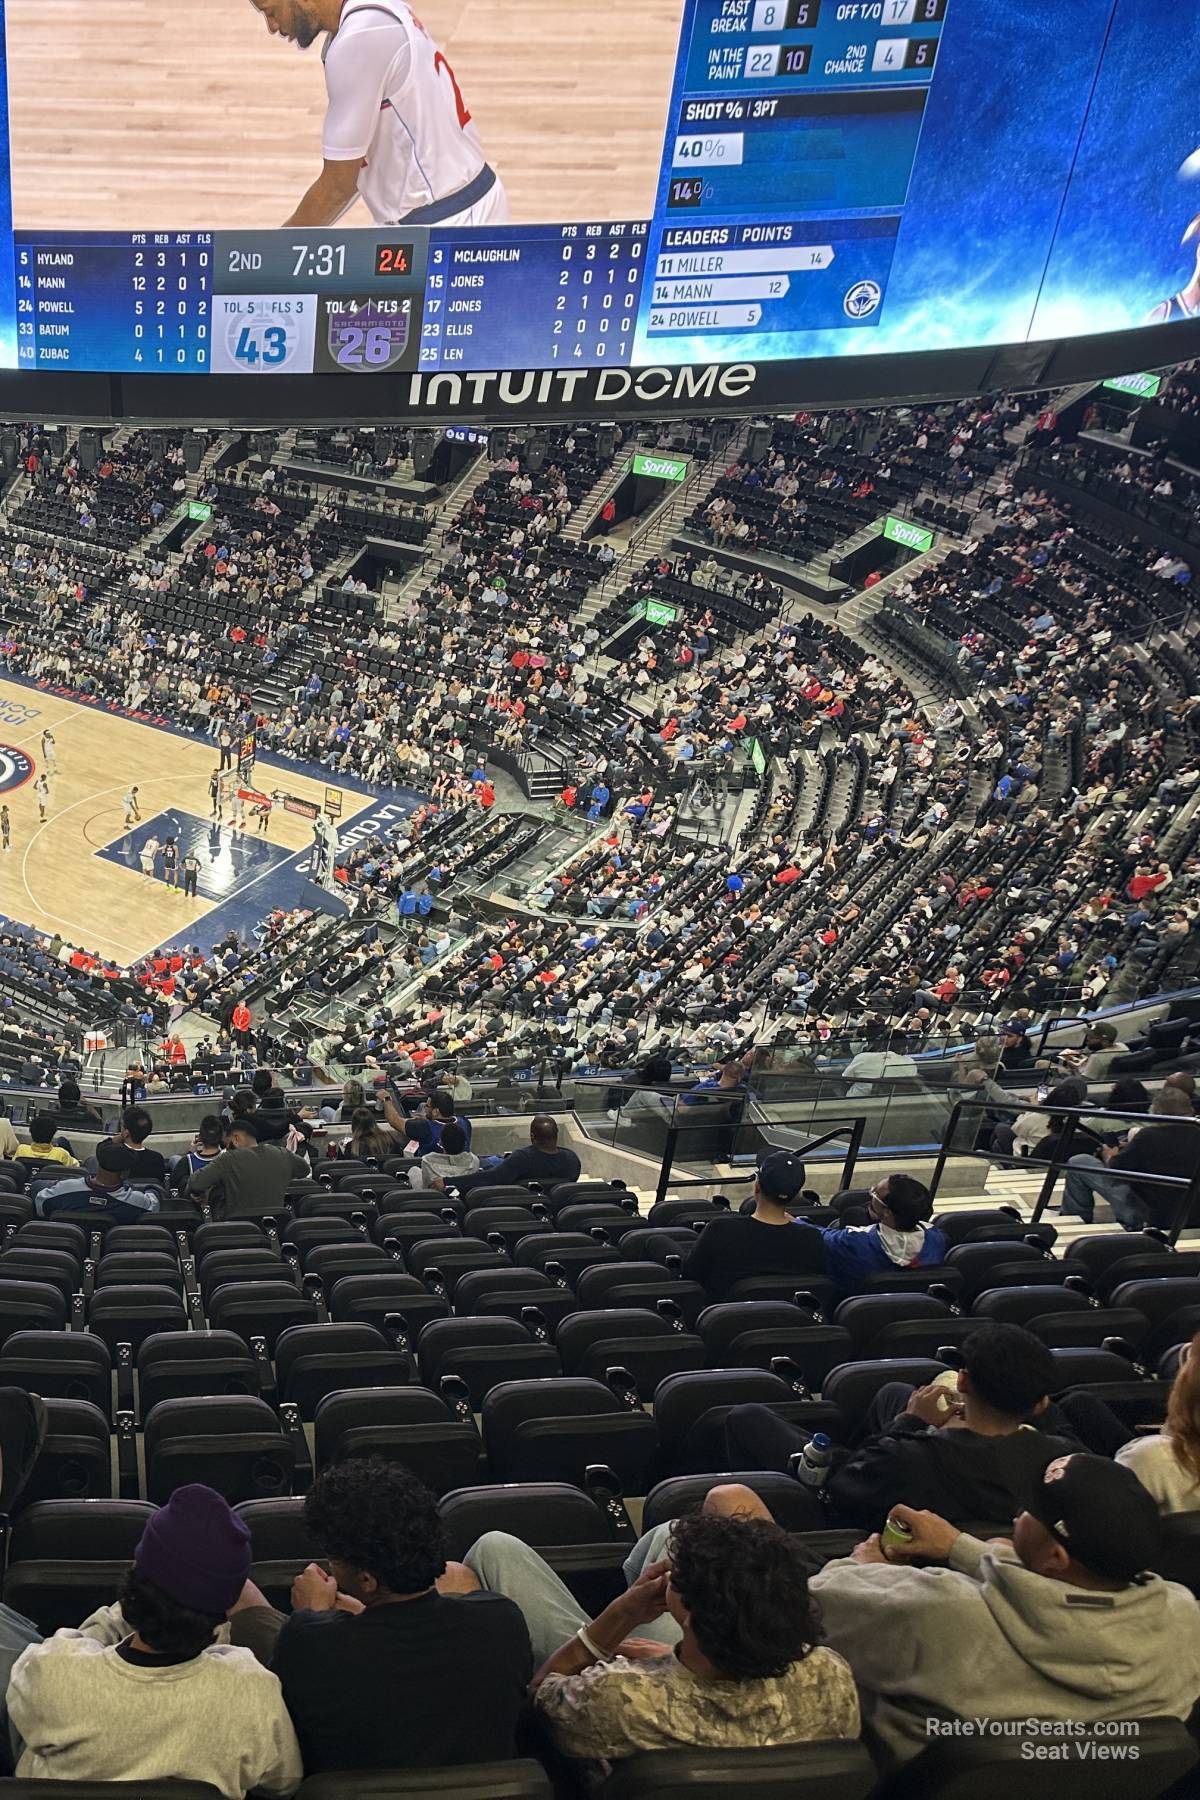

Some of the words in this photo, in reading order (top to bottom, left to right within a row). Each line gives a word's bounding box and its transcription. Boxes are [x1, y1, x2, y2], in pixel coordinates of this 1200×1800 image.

[722, 0, 750, 15] FAST
[764, 7, 775, 25] 8
[797, 5, 809, 24] 5
[837, 5, 859, 20] OFF
[861, 3, 881, 19] T/O
[892, 1, 908, 19] 17
[925, 0, 937, 17] 9
[711, 18, 747, 32] BREAK
[708, 49, 720, 63] IN
[723, 48, 744, 62] THE
[846, 45, 867, 58] 2ND
[884, 48, 893, 65] 4
[916, 45, 927, 64] 5
[751, 53, 772, 72] 22
[787, 51, 804, 70] 10
[825, 59, 864, 74] CHANCE
[709, 64, 741, 79] PAINT
[687, 103, 724, 120] SHOT
[726, 102, 742, 118] %
[753, 100, 778, 117] 3PT
[679, 140, 724, 157] 40%
[133, 234, 145, 243] PTS
[155, 235, 168, 243] REB
[176, 234, 190, 243] AST
[198, 234, 210, 243] FLS
[562, 226, 577, 236] PTS
[586, 226, 601, 235] REB
[609, 225, 625, 235] AST
[632, 224, 646, 234] FLS
[667, 229, 728, 245] LEADERS
[742, 226, 792, 242] POINTS
[21, 252, 27, 264] 5
[38, 254, 73, 265] HYLAND
[136, 253, 143, 266] 2
[158, 253, 165, 266] 3
[181, 253, 185, 266] 1
[200, 253, 207, 266] 0
[229, 251, 261, 271] 2ND
[293, 245, 345, 275] 7:31
[380, 250, 406, 271] 24
[434, 250, 442, 263] 3
[455, 250, 520, 262] MCLAUGHLIN
[563, 246, 571, 260] 0
[587, 245, 595, 259] 3
[610, 244, 619, 258] 2
[632, 243, 641, 257] 0
[661, 259, 672, 273] 11
[678, 257, 723, 272] MILLER
[811, 253, 821, 264] 14
[19, 276, 31, 288] 14
[38, 278, 65, 288] MANN
[133, 277, 145, 290] 12
[158, 277, 165, 290] 2
[179, 277, 186, 290] 0
[200, 277, 205, 290] 1
[430, 275, 443, 288] 15
[451, 276, 484, 287] JONES
[560, 271, 568, 284] 2
[584, 271, 592, 284] 0
[609, 270, 614, 283] 1
[628, 269, 637, 282] 0
[657, 287, 668, 299] 14
[674, 284, 712, 299] MANN
[770, 282, 781, 293] 12
[19, 300, 33, 312] 24
[39, 302, 74, 312] POWELL
[136, 301, 142, 314] 5
[157, 301, 164, 314] 2
[179, 302, 185, 314] 0
[199, 302, 206, 314] 2
[224, 303, 242, 313] TOL
[248, 302, 254, 313] 5
[272, 302, 290, 313] FLS
[296, 302, 303, 313] 3
[326, 302, 345, 313] TOL
[350, 300, 358, 313] 4
[378, 301, 397, 312] FLS
[402, 300, 410, 312] 2
[428, 300, 441, 312] 17
[449, 301, 481, 312] JONES
[557, 296, 565, 309] 2
[582, 296, 587, 309] 1
[603, 295, 612, 308] 0
[625, 294, 633, 307] 0
[424, 324, 439, 336] 23
[447, 325, 472, 335] ELLIS
[554, 320, 562, 333] 2
[577, 320, 585, 332] 0
[600, 319, 608, 332] 0
[621, 318, 630, 331] 0
[651, 315, 664, 325] 24
[669, 311, 719, 326] POWELL
[748, 311, 755, 321] 5
[20, 323, 33, 334] 33
[40, 325, 69, 335] BATUM
[136, 325, 142, 337] 0
[158, 325, 162, 337] 1
[179, 325, 184, 338] 1
[198, 325, 205, 338] 0
[235, 327, 286, 363] 43
[337, 327, 390, 363] 26
[421, 348, 437, 360] 25
[444, 349, 463, 359] LEN
[553, 345, 557, 357] 1
[574, 344, 582, 357] 4
[597, 343, 605, 356] 0
[620, 343, 625, 355] 1
[20, 347, 34, 358] 40
[40, 348, 69, 359] ZUBAC
[135, 349, 142, 361] 4
[158, 349, 162, 362] 1
[178, 349, 185, 362] 0
[198, 350, 204, 362] 0
[642, 459, 678, 476] Sprite
[371, 804, 406, 820] LA
